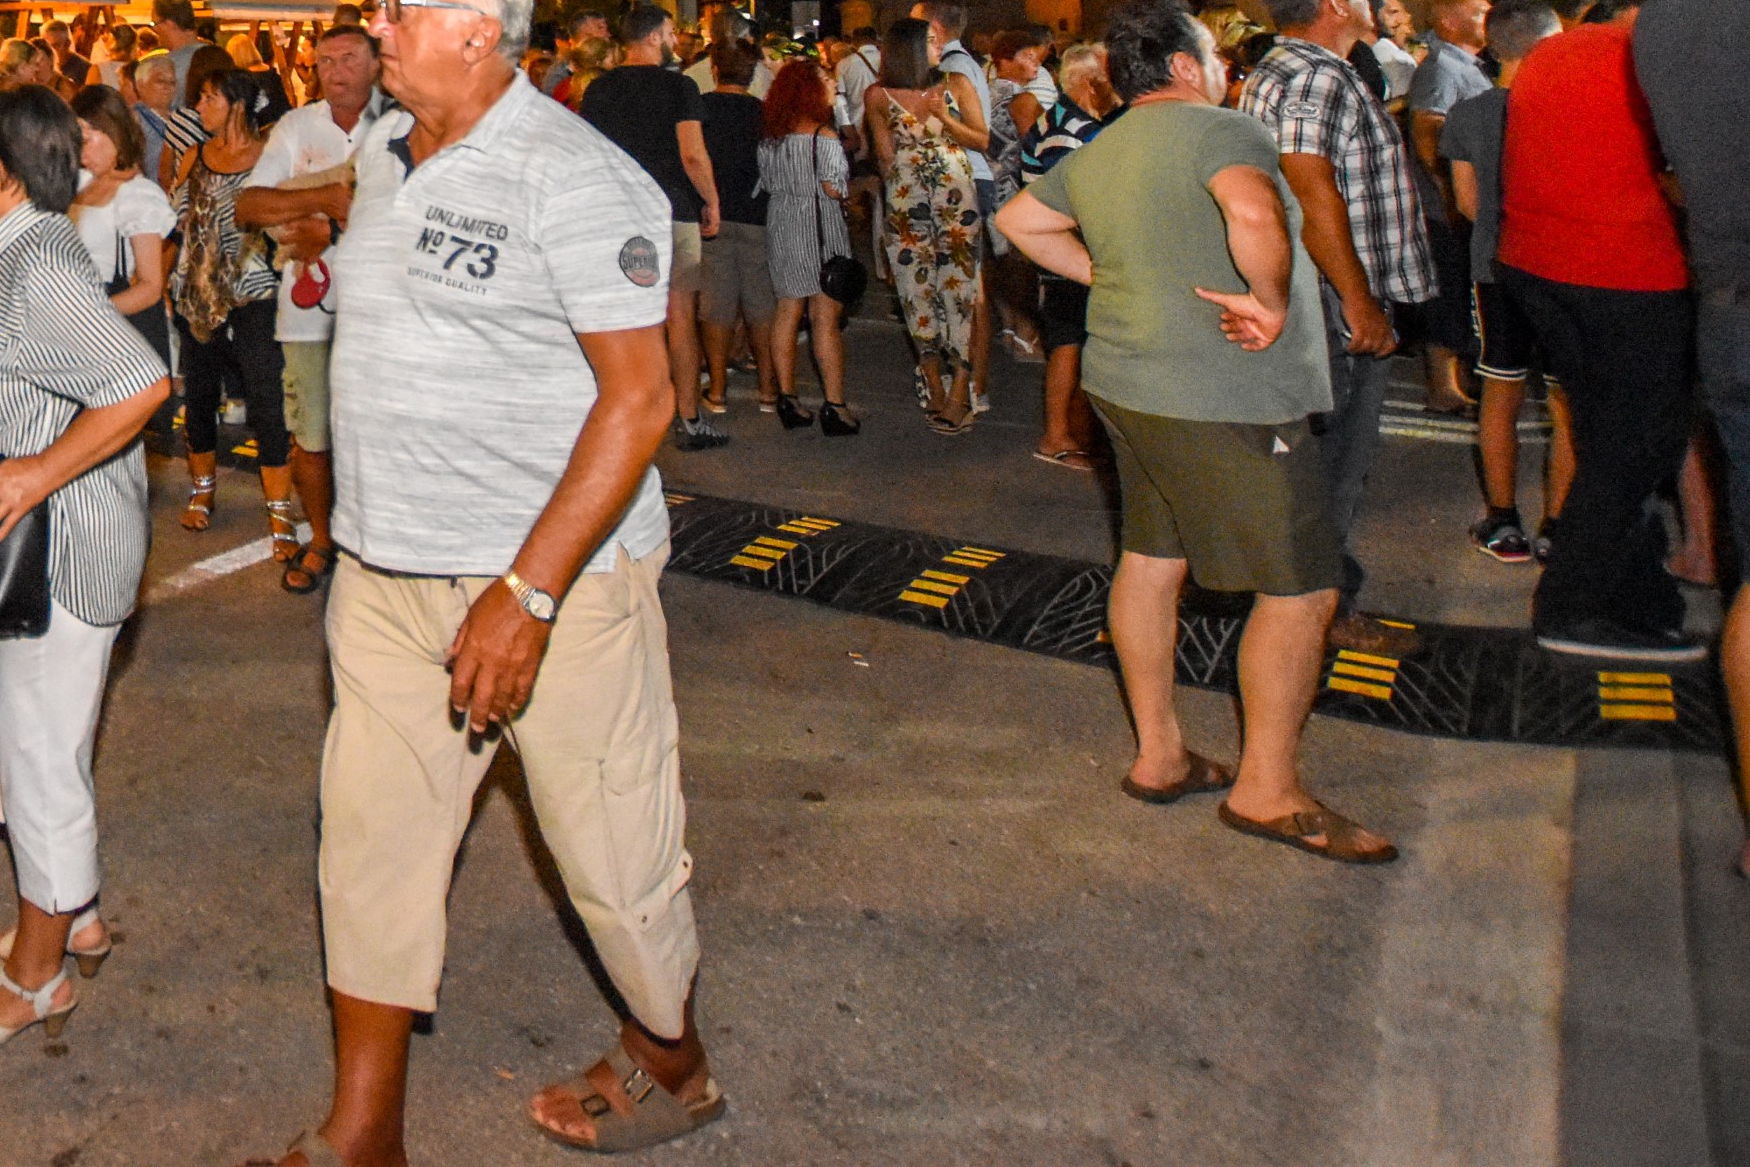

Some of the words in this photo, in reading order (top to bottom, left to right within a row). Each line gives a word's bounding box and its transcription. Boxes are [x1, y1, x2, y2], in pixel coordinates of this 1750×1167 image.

[425, 205, 509, 240] UNLIMITED
[443, 234, 499, 280] 73
[445, 277, 488, 296] QUALITY
